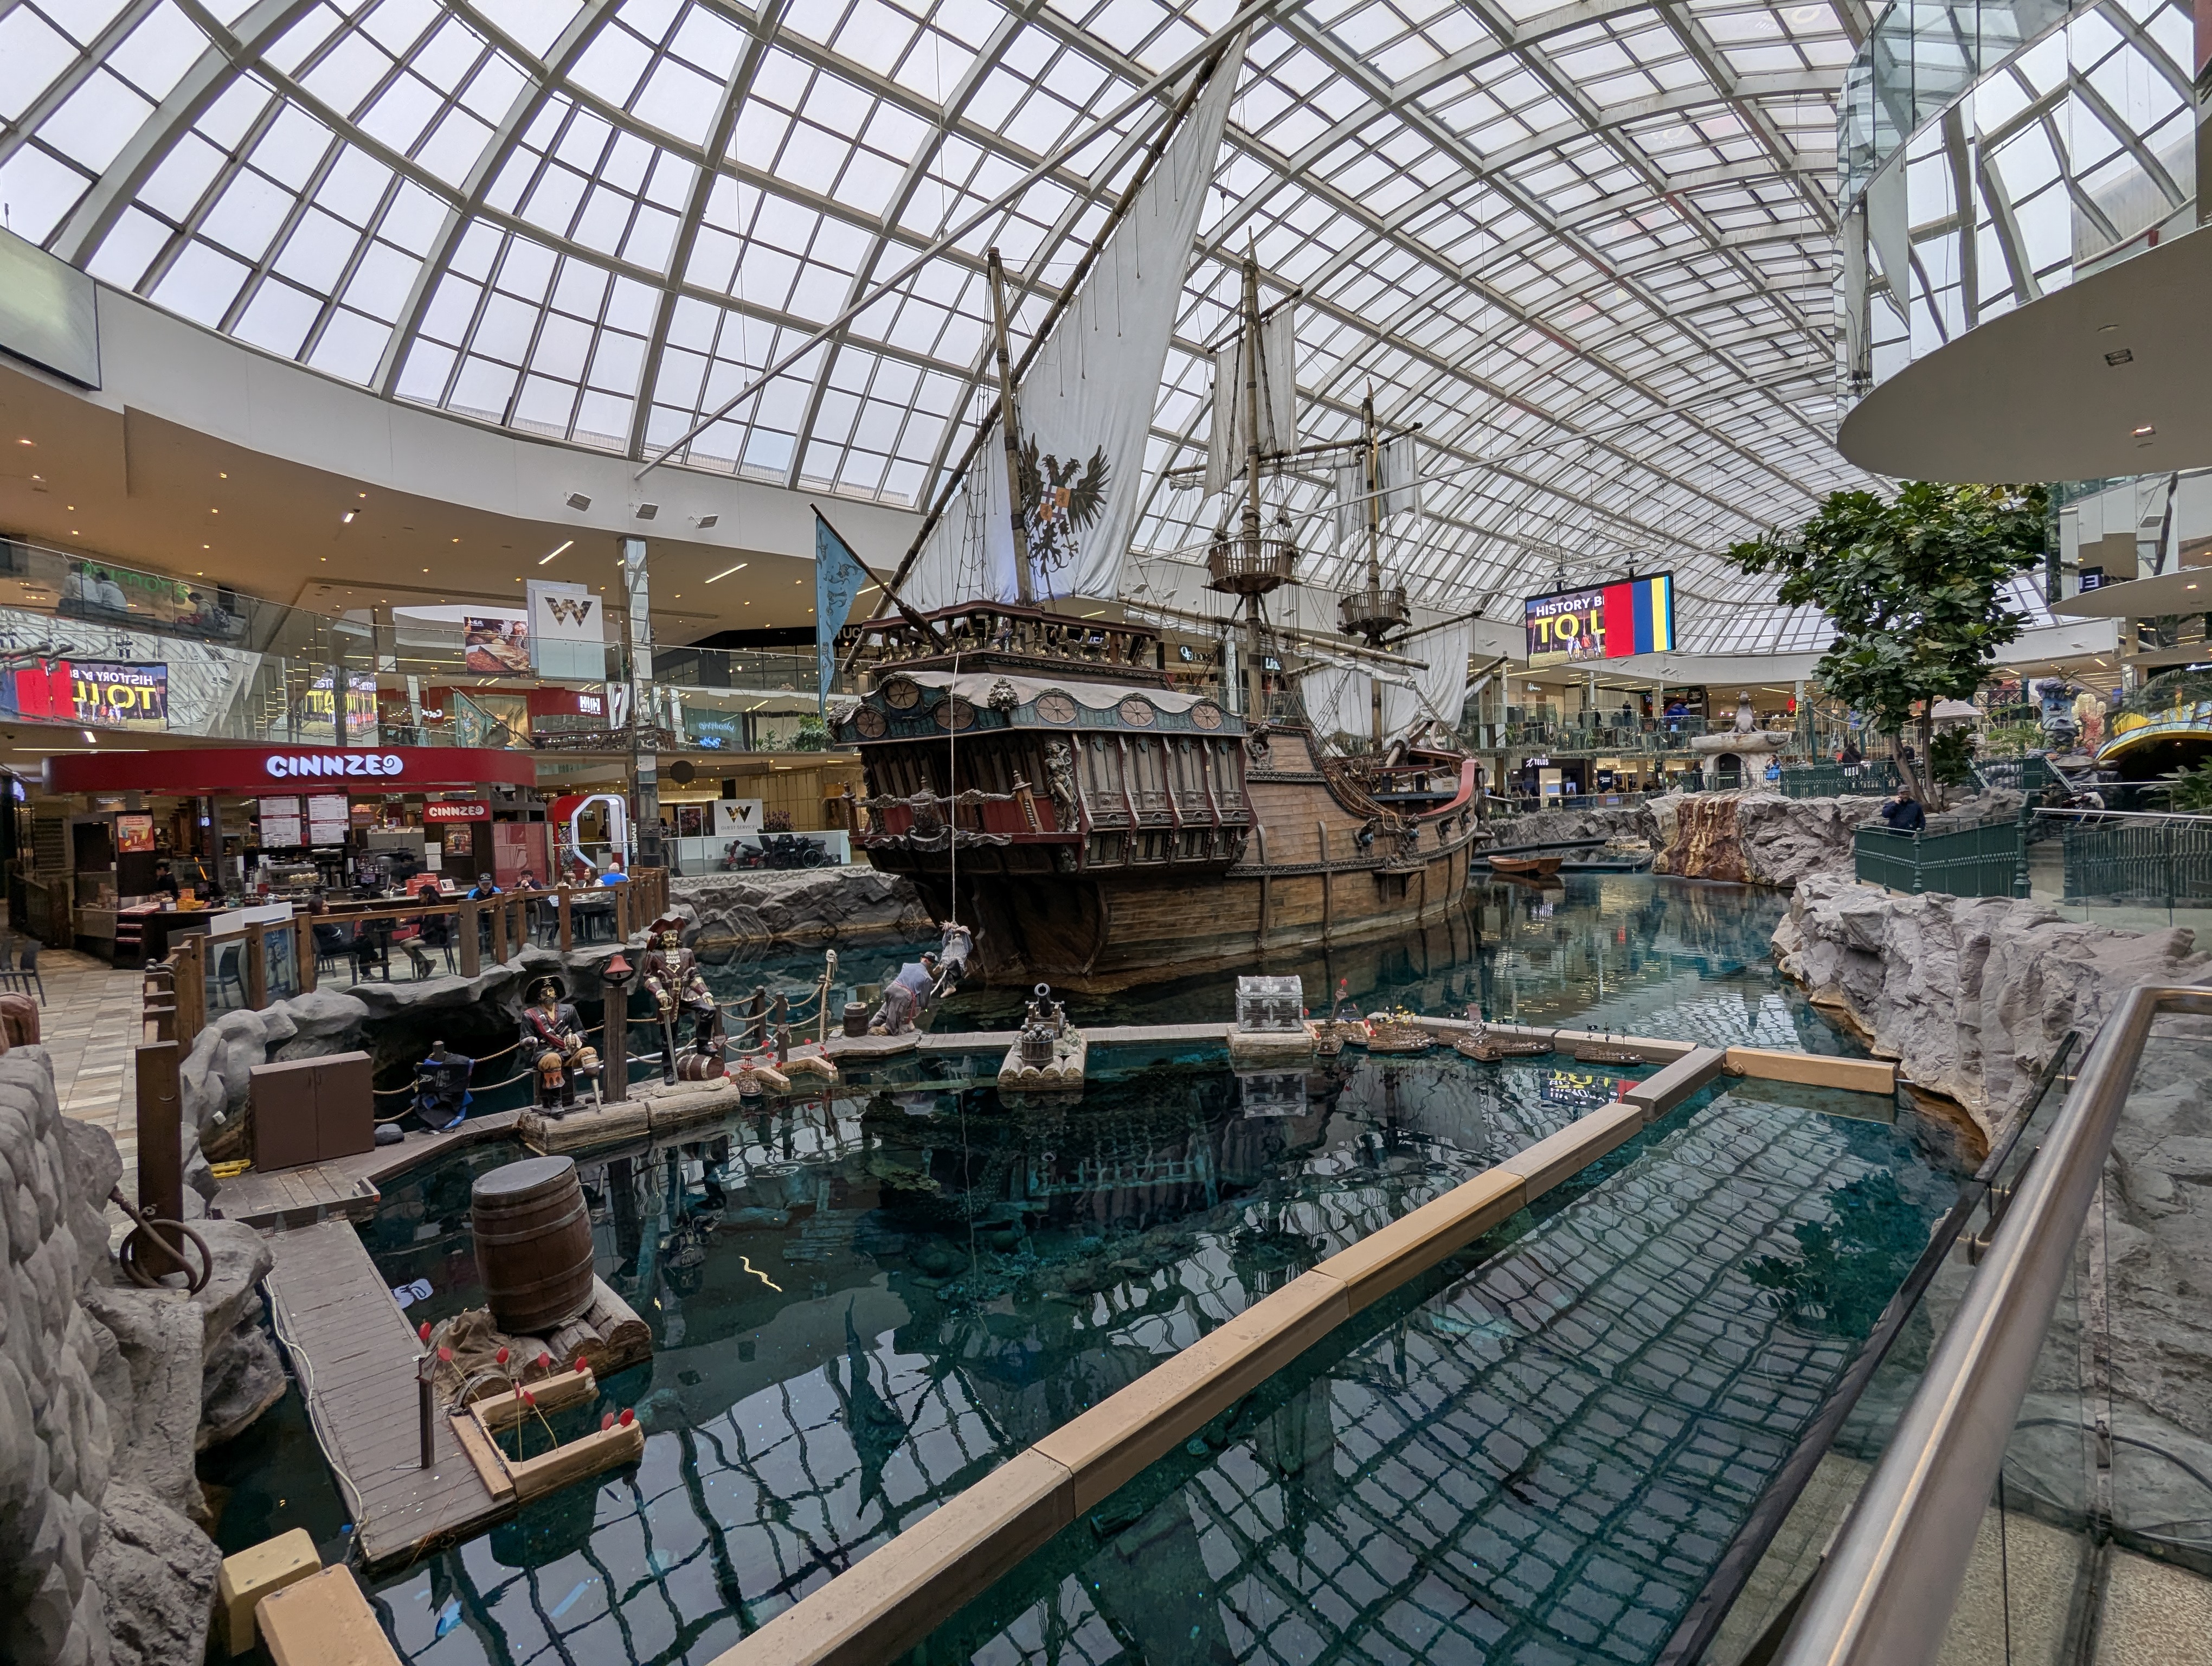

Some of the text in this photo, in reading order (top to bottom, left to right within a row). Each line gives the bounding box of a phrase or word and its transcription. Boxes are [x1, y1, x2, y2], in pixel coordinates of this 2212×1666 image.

[544, 597, 593, 627] W
[1536, 598, 1590, 617] HISTORY
[1535, 613, 1579, 644] TO
[267, 755, 403, 777] CINNZEO
[429, 806, 484, 817] CINNZEO
[725, 806, 752, 823] W
